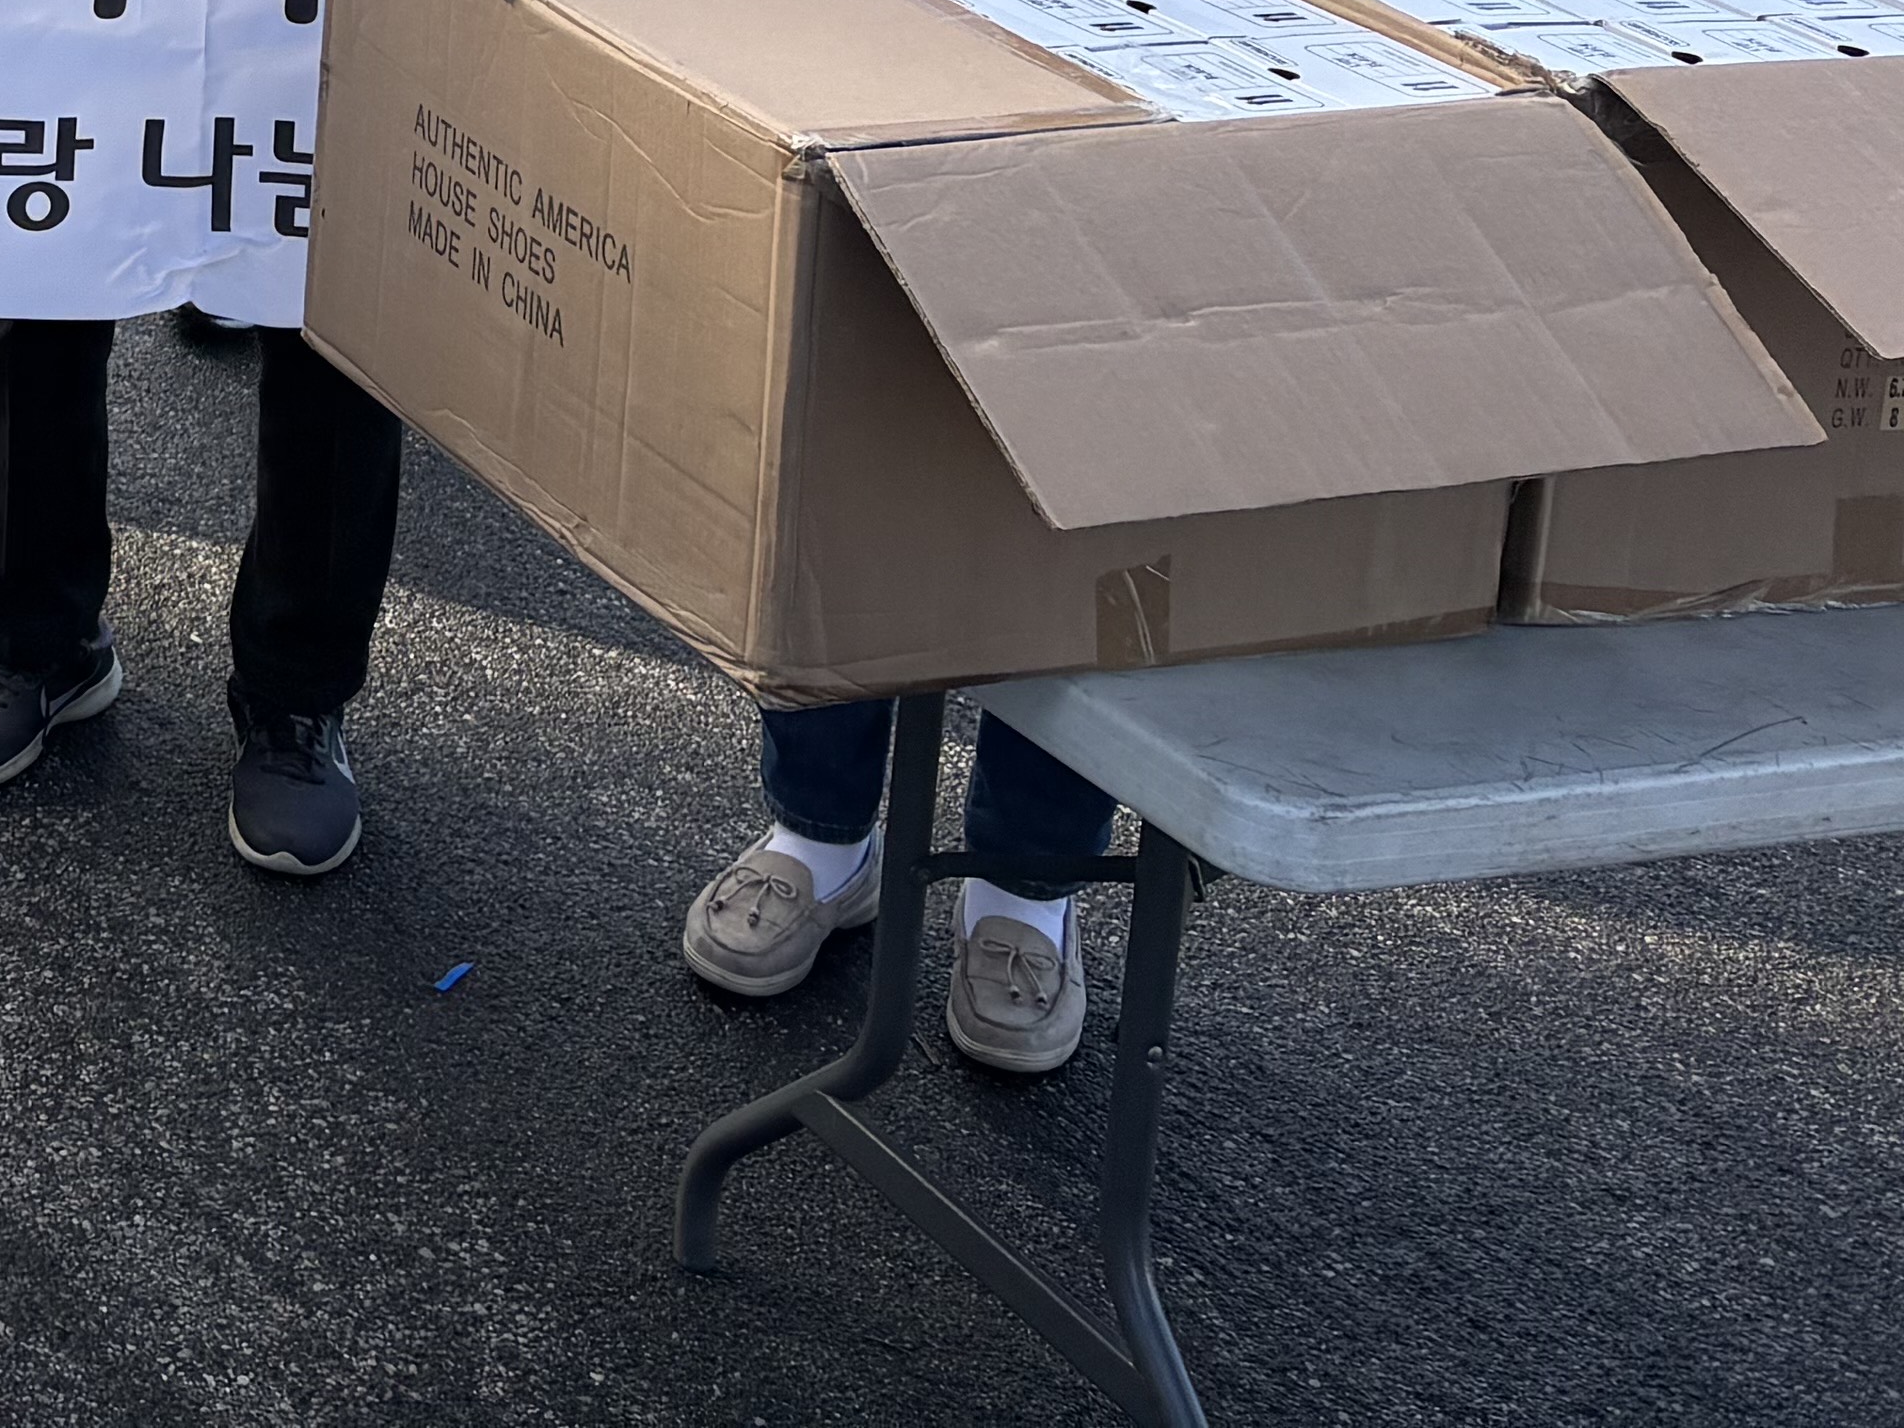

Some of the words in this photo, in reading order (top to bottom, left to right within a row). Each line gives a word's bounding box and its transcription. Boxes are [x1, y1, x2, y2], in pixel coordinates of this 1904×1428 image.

[411, 150, 478, 228] HOUSE
[487, 206, 556, 285] SHOES
[413, 103, 523, 206] AUTHENTIC
[531, 187, 632, 285] AMERICA
[408, 199, 462, 269] MADE
[471, 246, 491, 292] IN
[501, 271, 565, 349] CHINA
[1889, 377, 1904, 398] 6.
